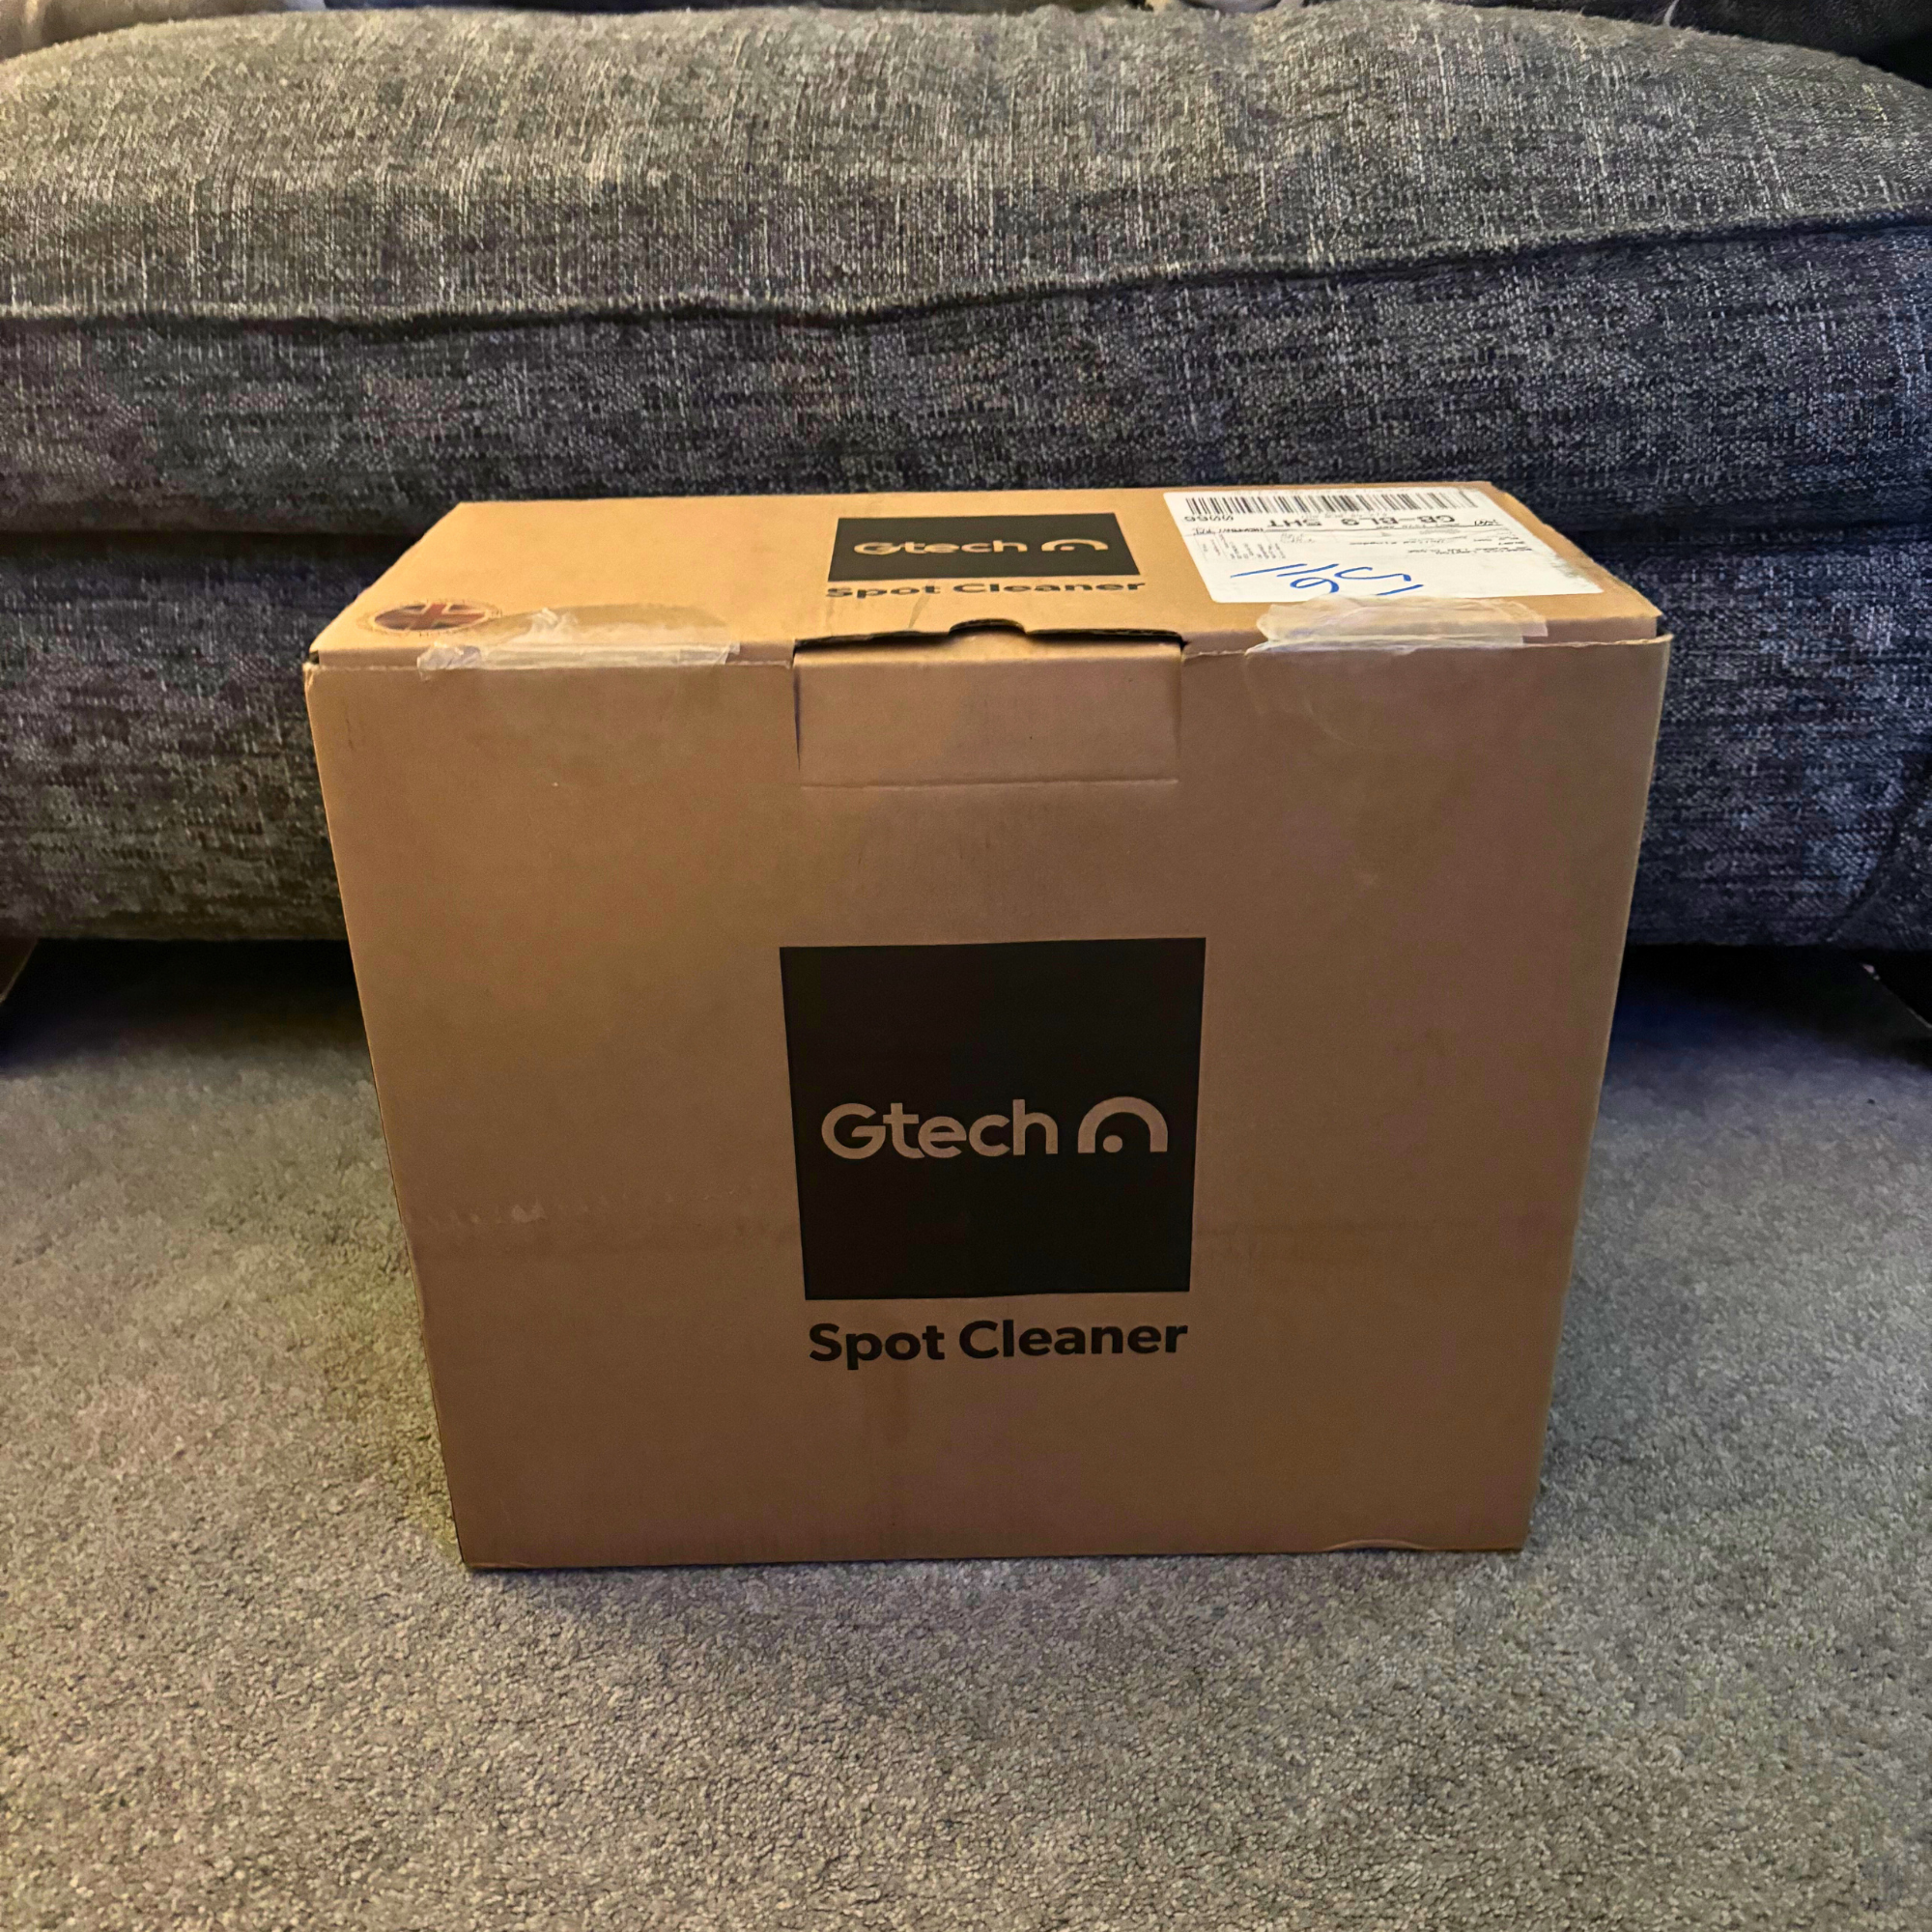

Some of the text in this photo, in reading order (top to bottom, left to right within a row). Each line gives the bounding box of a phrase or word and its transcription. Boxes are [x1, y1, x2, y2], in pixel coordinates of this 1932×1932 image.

[854, 539, 1028, 555] Gtech
[826, 582, 1147, 599] Spot Cleaner
[821, 1098, 1059, 1159] Gtech
[809, 1319, 1189, 1370] Spot Cleaner
